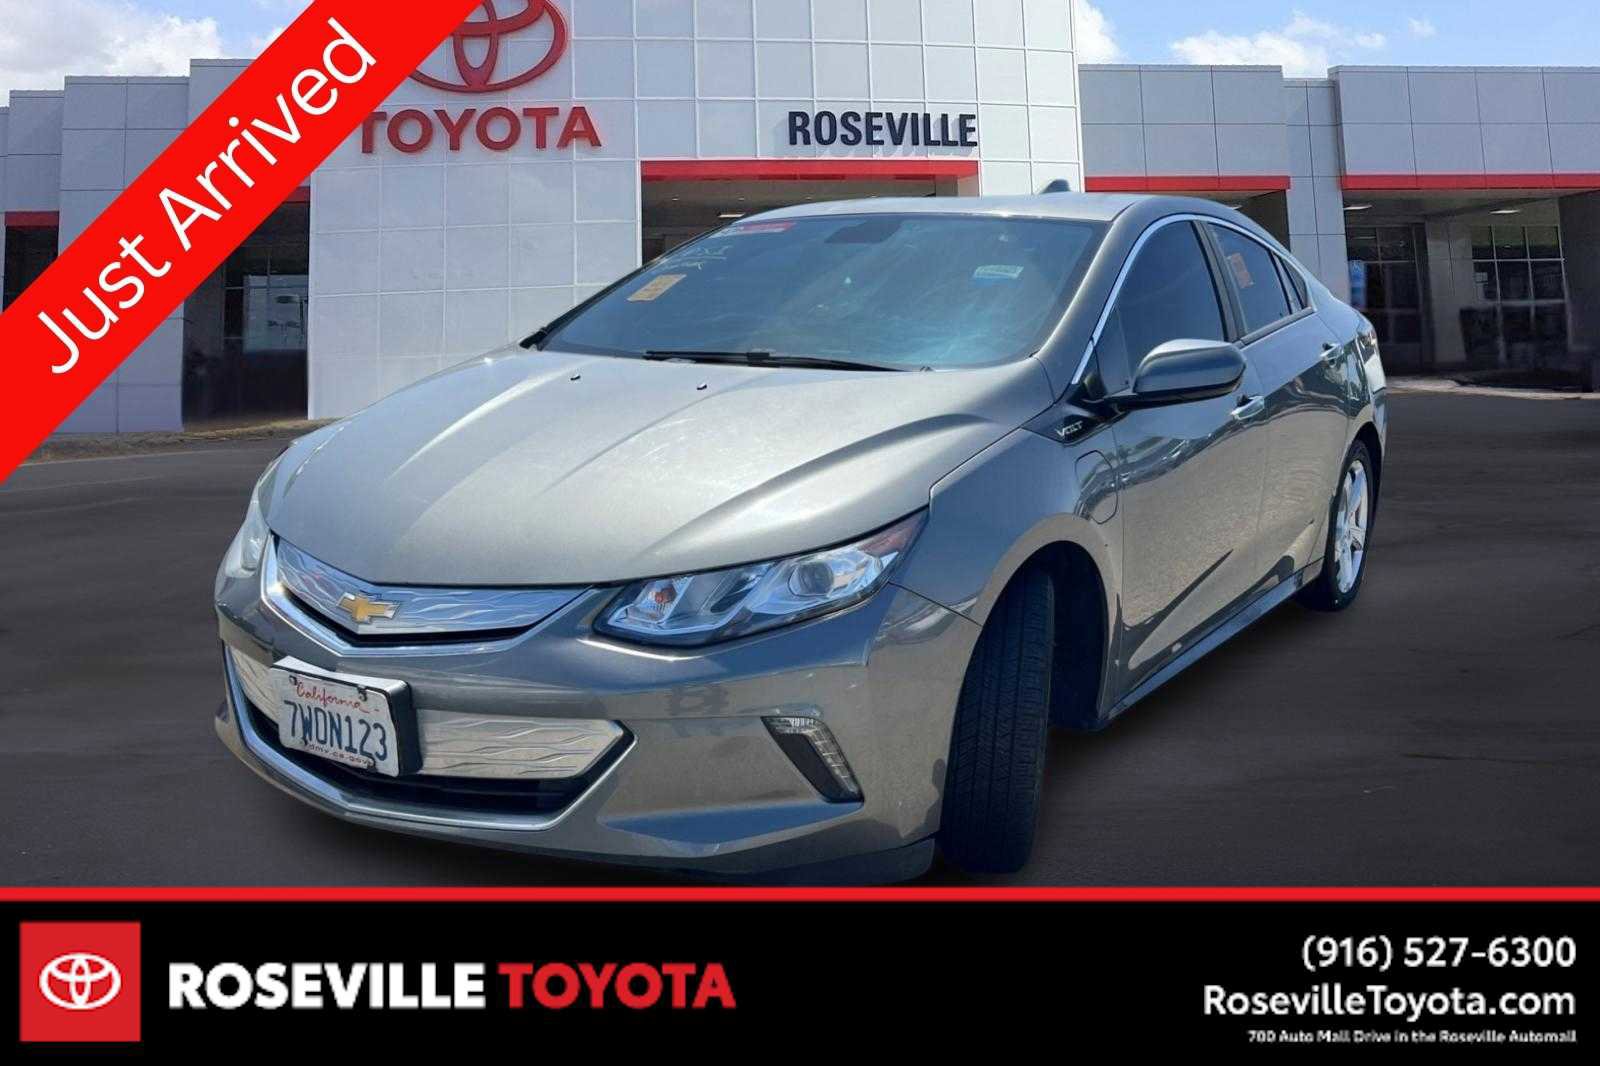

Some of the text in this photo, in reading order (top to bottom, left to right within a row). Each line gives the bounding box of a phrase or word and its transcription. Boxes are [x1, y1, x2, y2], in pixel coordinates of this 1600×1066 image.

[361, 106, 602, 154] TOYOTA
[788, 110, 978, 147] ROSEVILLE
[1055, 420, 1083, 438] VOLT
[296, 681, 370, 714] California
[283, 699, 388, 762] 7WDN123
